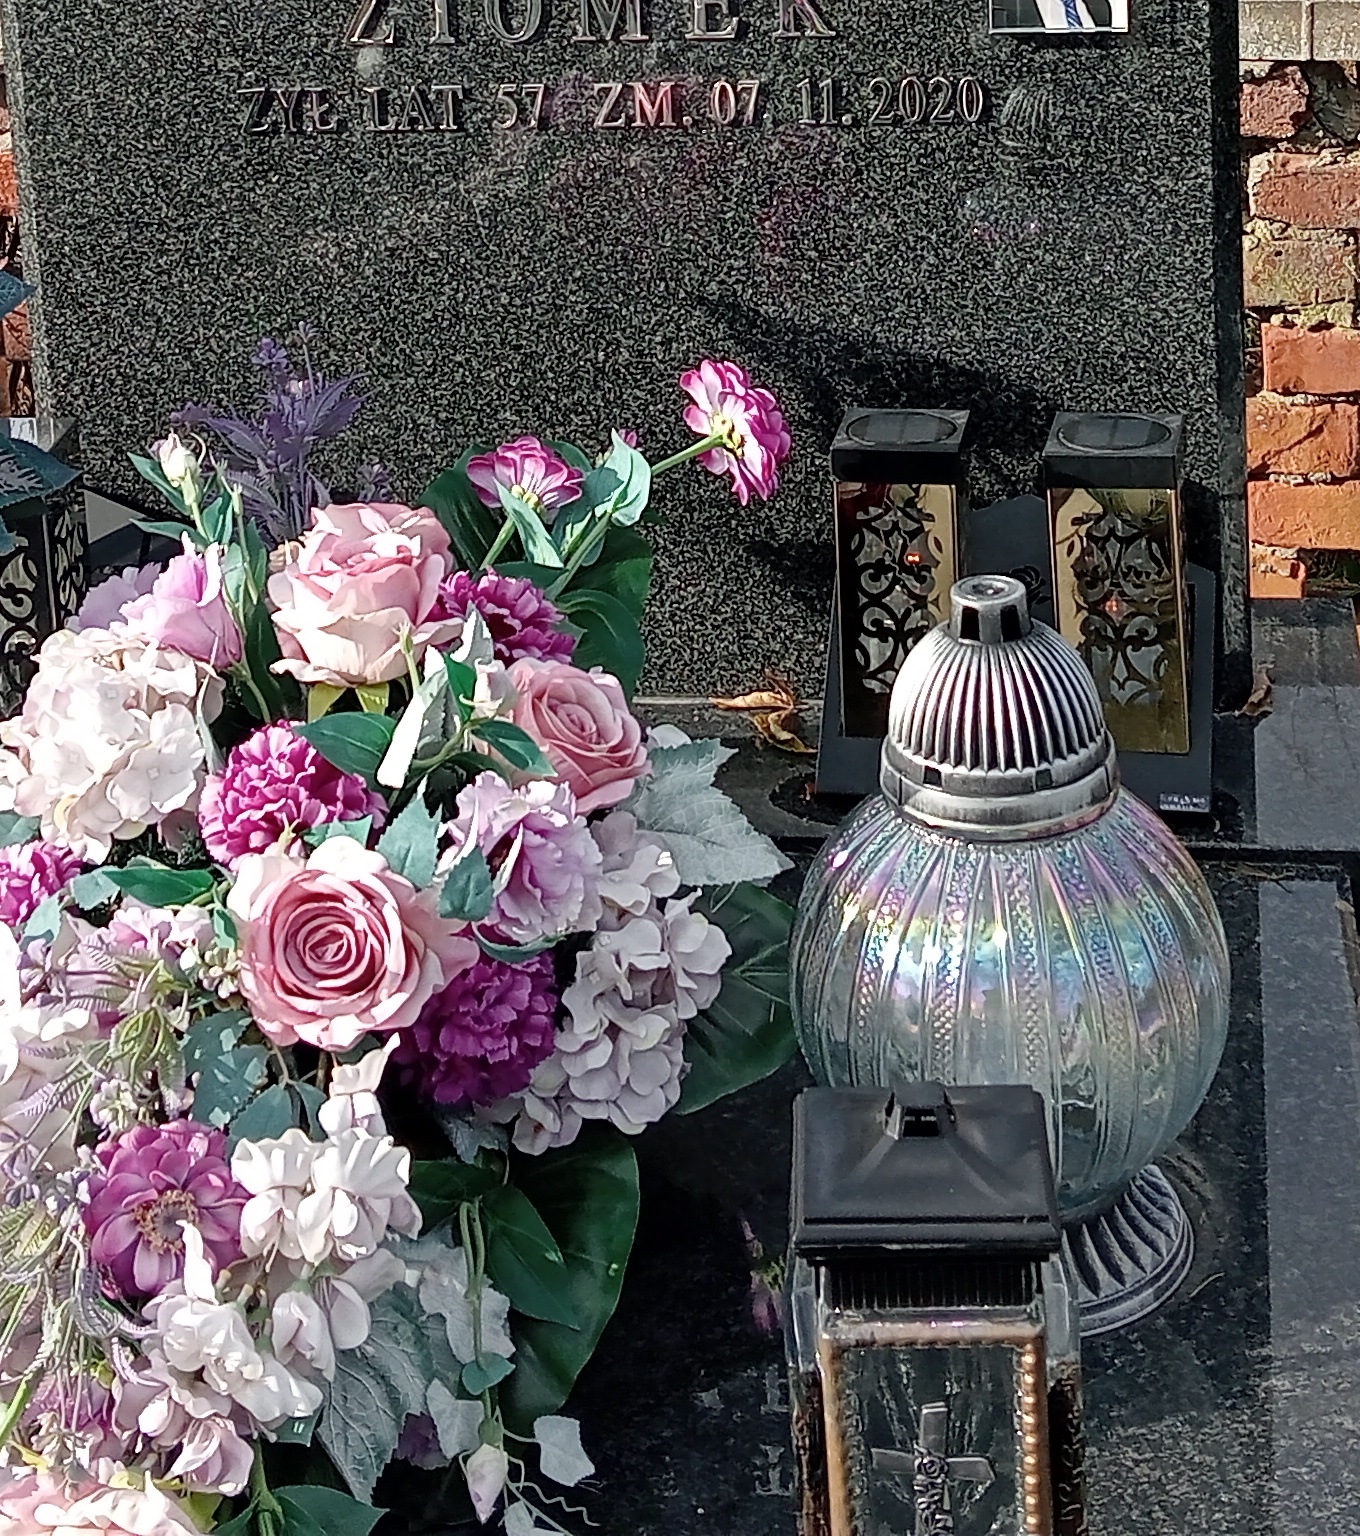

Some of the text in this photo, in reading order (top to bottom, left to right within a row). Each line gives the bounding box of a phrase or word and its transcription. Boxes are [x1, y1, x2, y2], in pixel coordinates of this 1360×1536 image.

[364, 83, 465, 133] LAT
[494, 81, 546, 129] 57
[592, 80, 695, 128] ZM.
